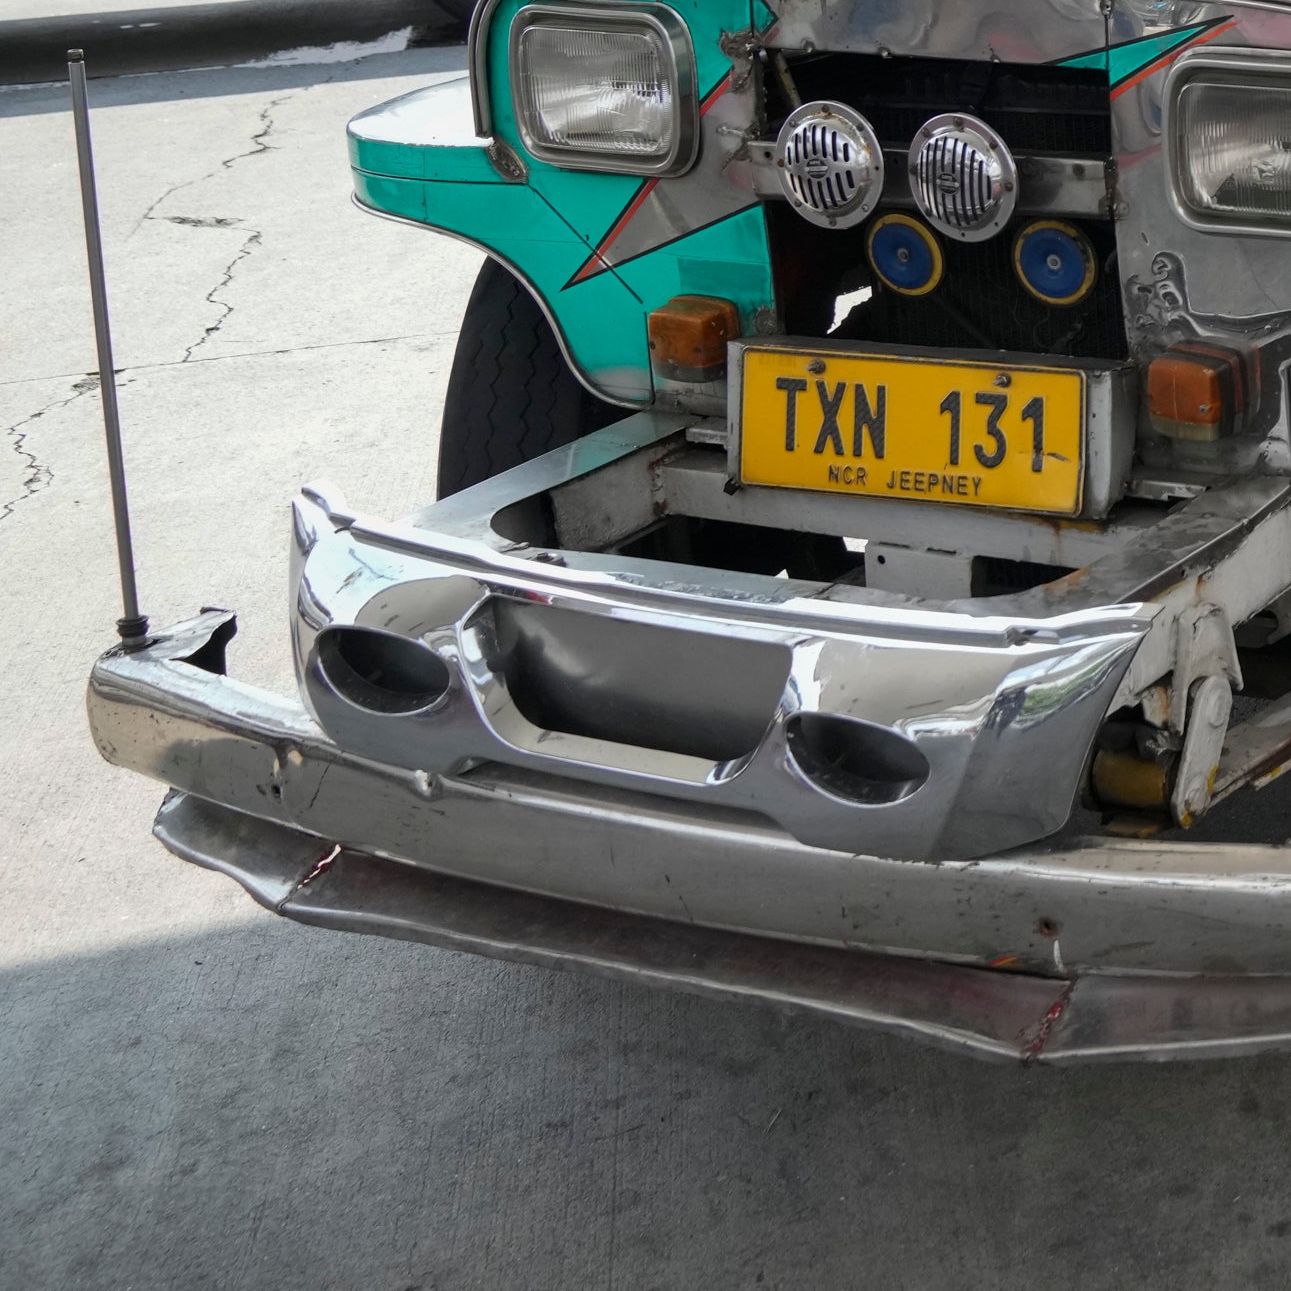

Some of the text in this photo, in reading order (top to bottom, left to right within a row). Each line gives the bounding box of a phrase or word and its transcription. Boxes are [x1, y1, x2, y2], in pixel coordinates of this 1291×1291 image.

[776, 375, 1046, 473] TXN 131
[827, 463, 984, 497] NCR JEEPNEY
